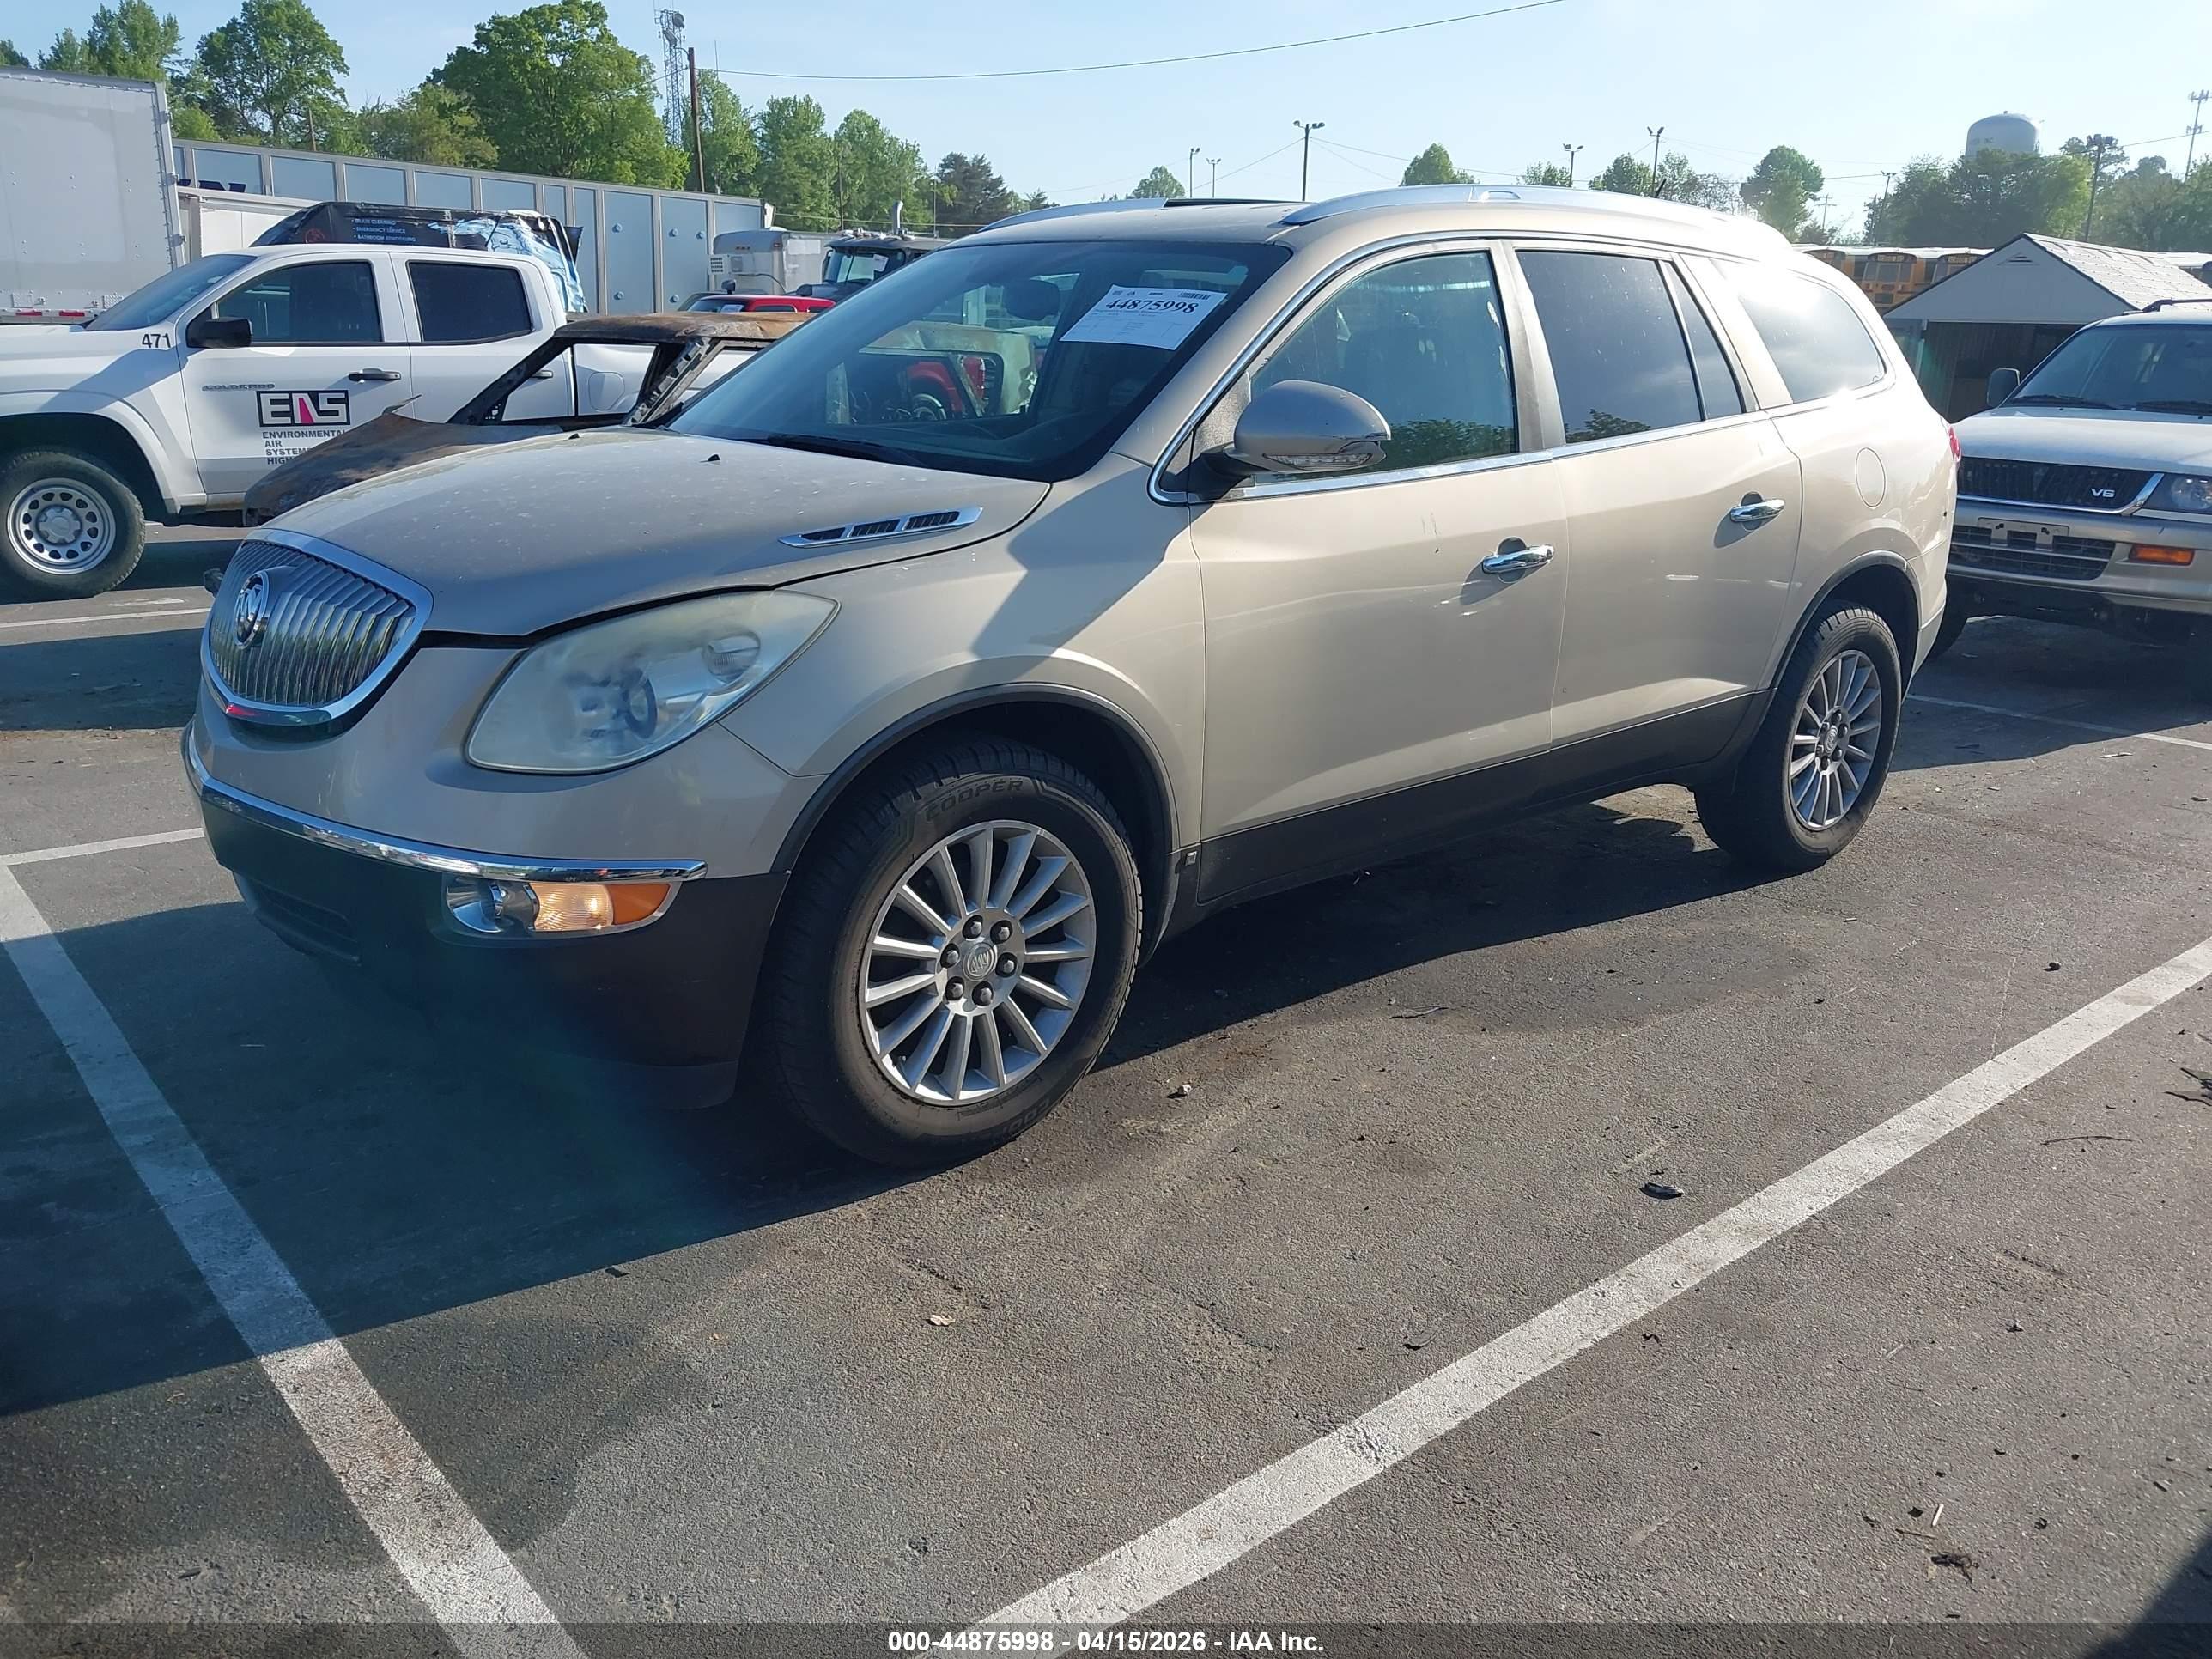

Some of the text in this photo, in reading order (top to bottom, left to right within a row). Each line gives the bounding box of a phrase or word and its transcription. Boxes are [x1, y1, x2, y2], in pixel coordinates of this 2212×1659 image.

[1106, 299, 1200, 313] 44875998
[142, 333, 171, 349] 471
[2091, 488, 2115, 498] V6
